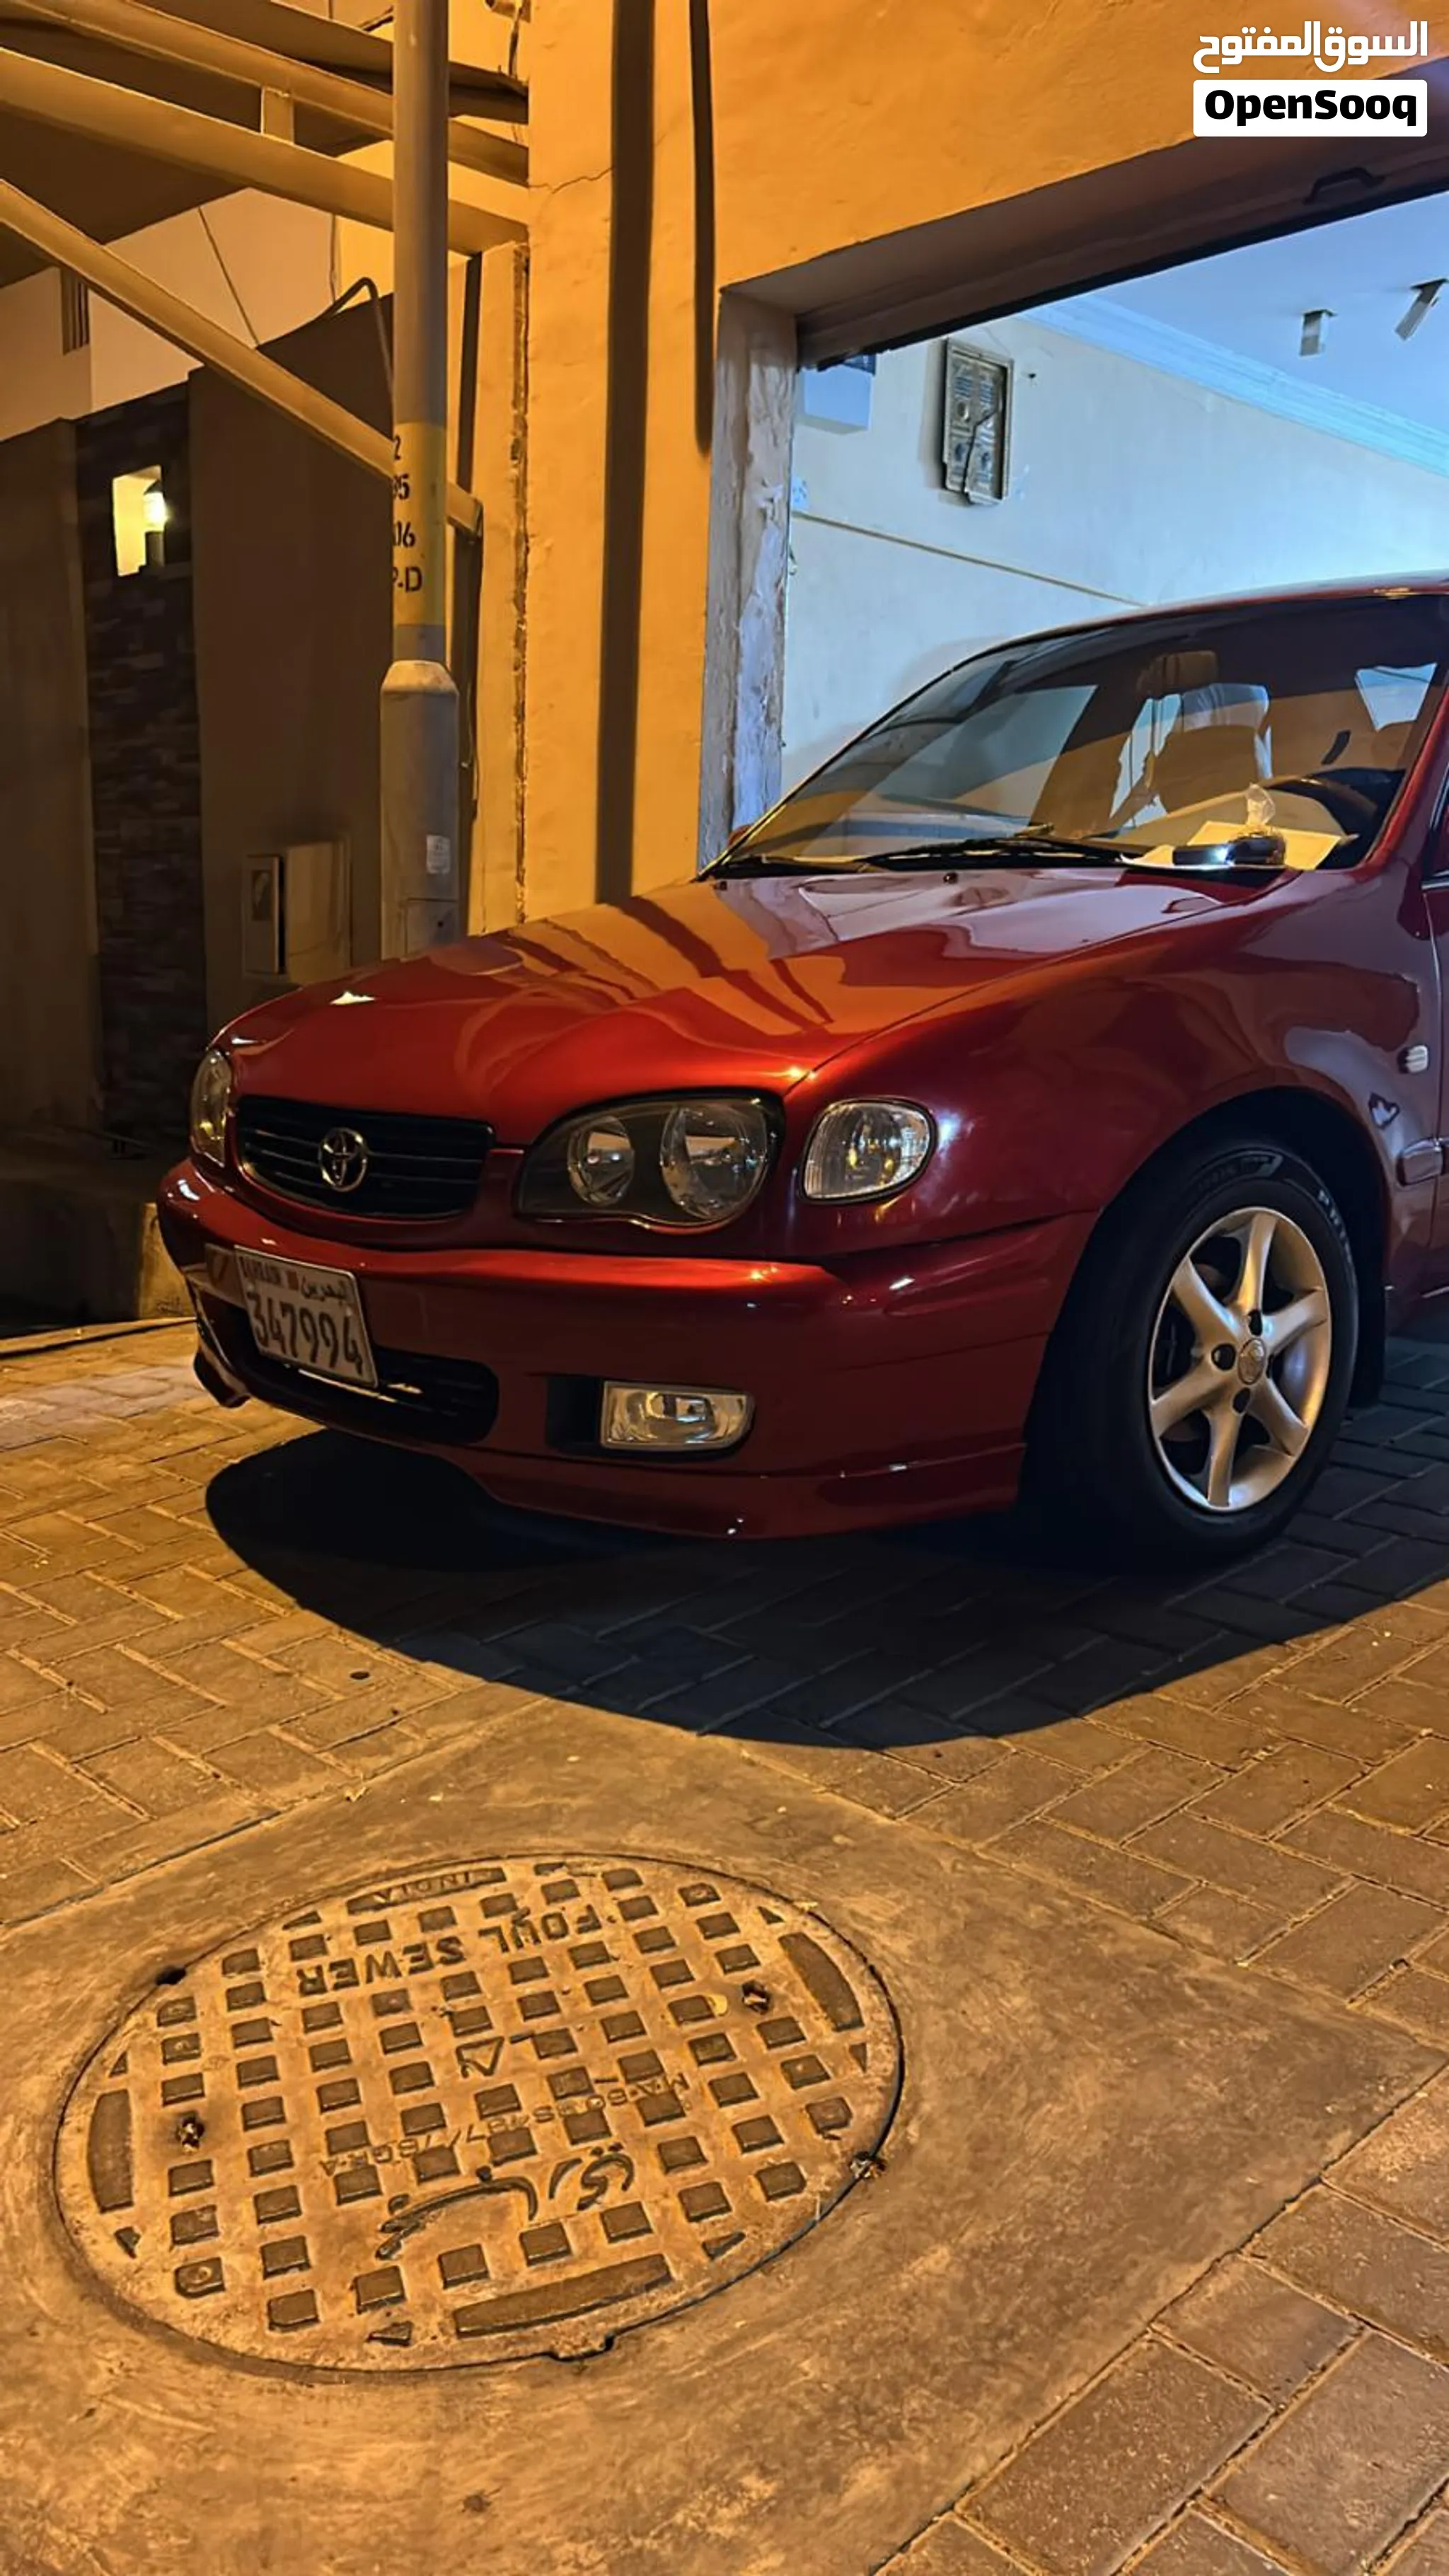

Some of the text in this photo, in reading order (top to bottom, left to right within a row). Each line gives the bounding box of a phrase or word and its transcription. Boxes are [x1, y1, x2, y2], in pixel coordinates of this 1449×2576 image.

[248, 1290, 364, 1375] 347994
[297, 1904, 601, 1996] FOUL SEWER
